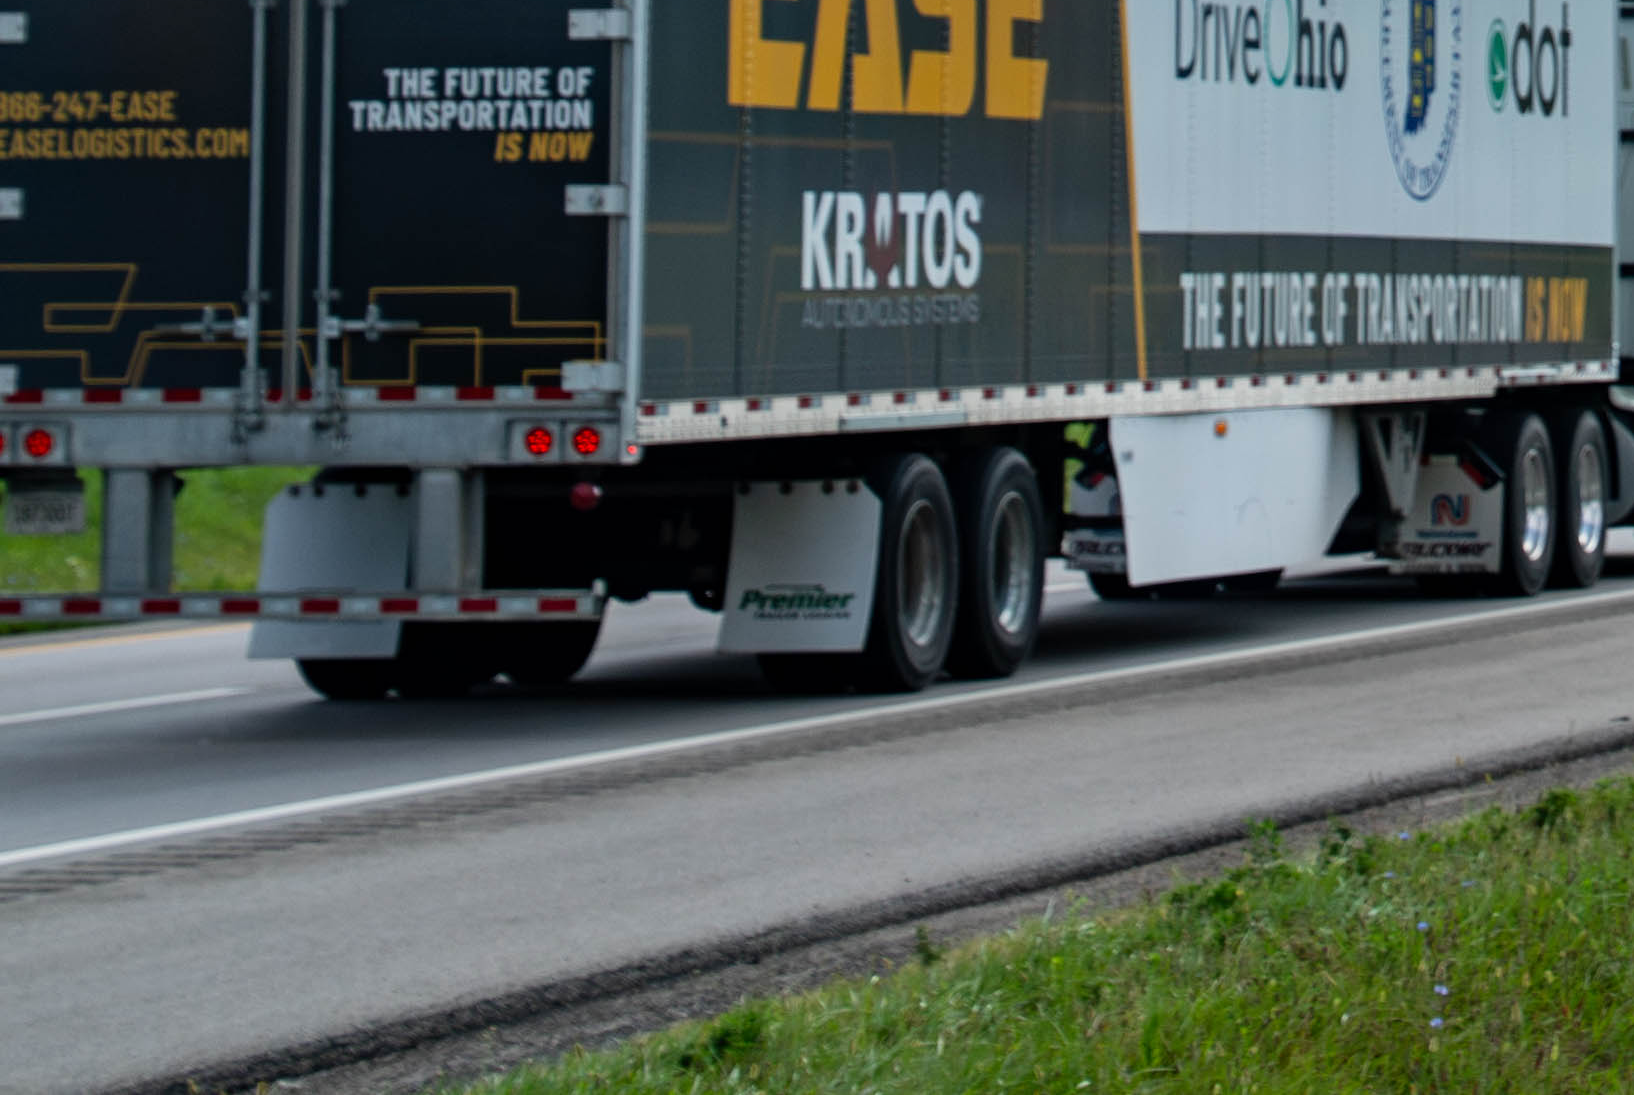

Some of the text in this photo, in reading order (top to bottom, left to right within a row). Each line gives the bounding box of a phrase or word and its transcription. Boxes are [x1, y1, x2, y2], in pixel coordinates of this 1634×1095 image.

[384, 67, 594, 98] THE FUTURE OF
[349, 99, 593, 131] TRANSPORTATION
[494, 130, 595, 162] IS NOW
[1179, 272, 1588, 350] THE FUTURE OF TRANSPORTATION IS NOW
